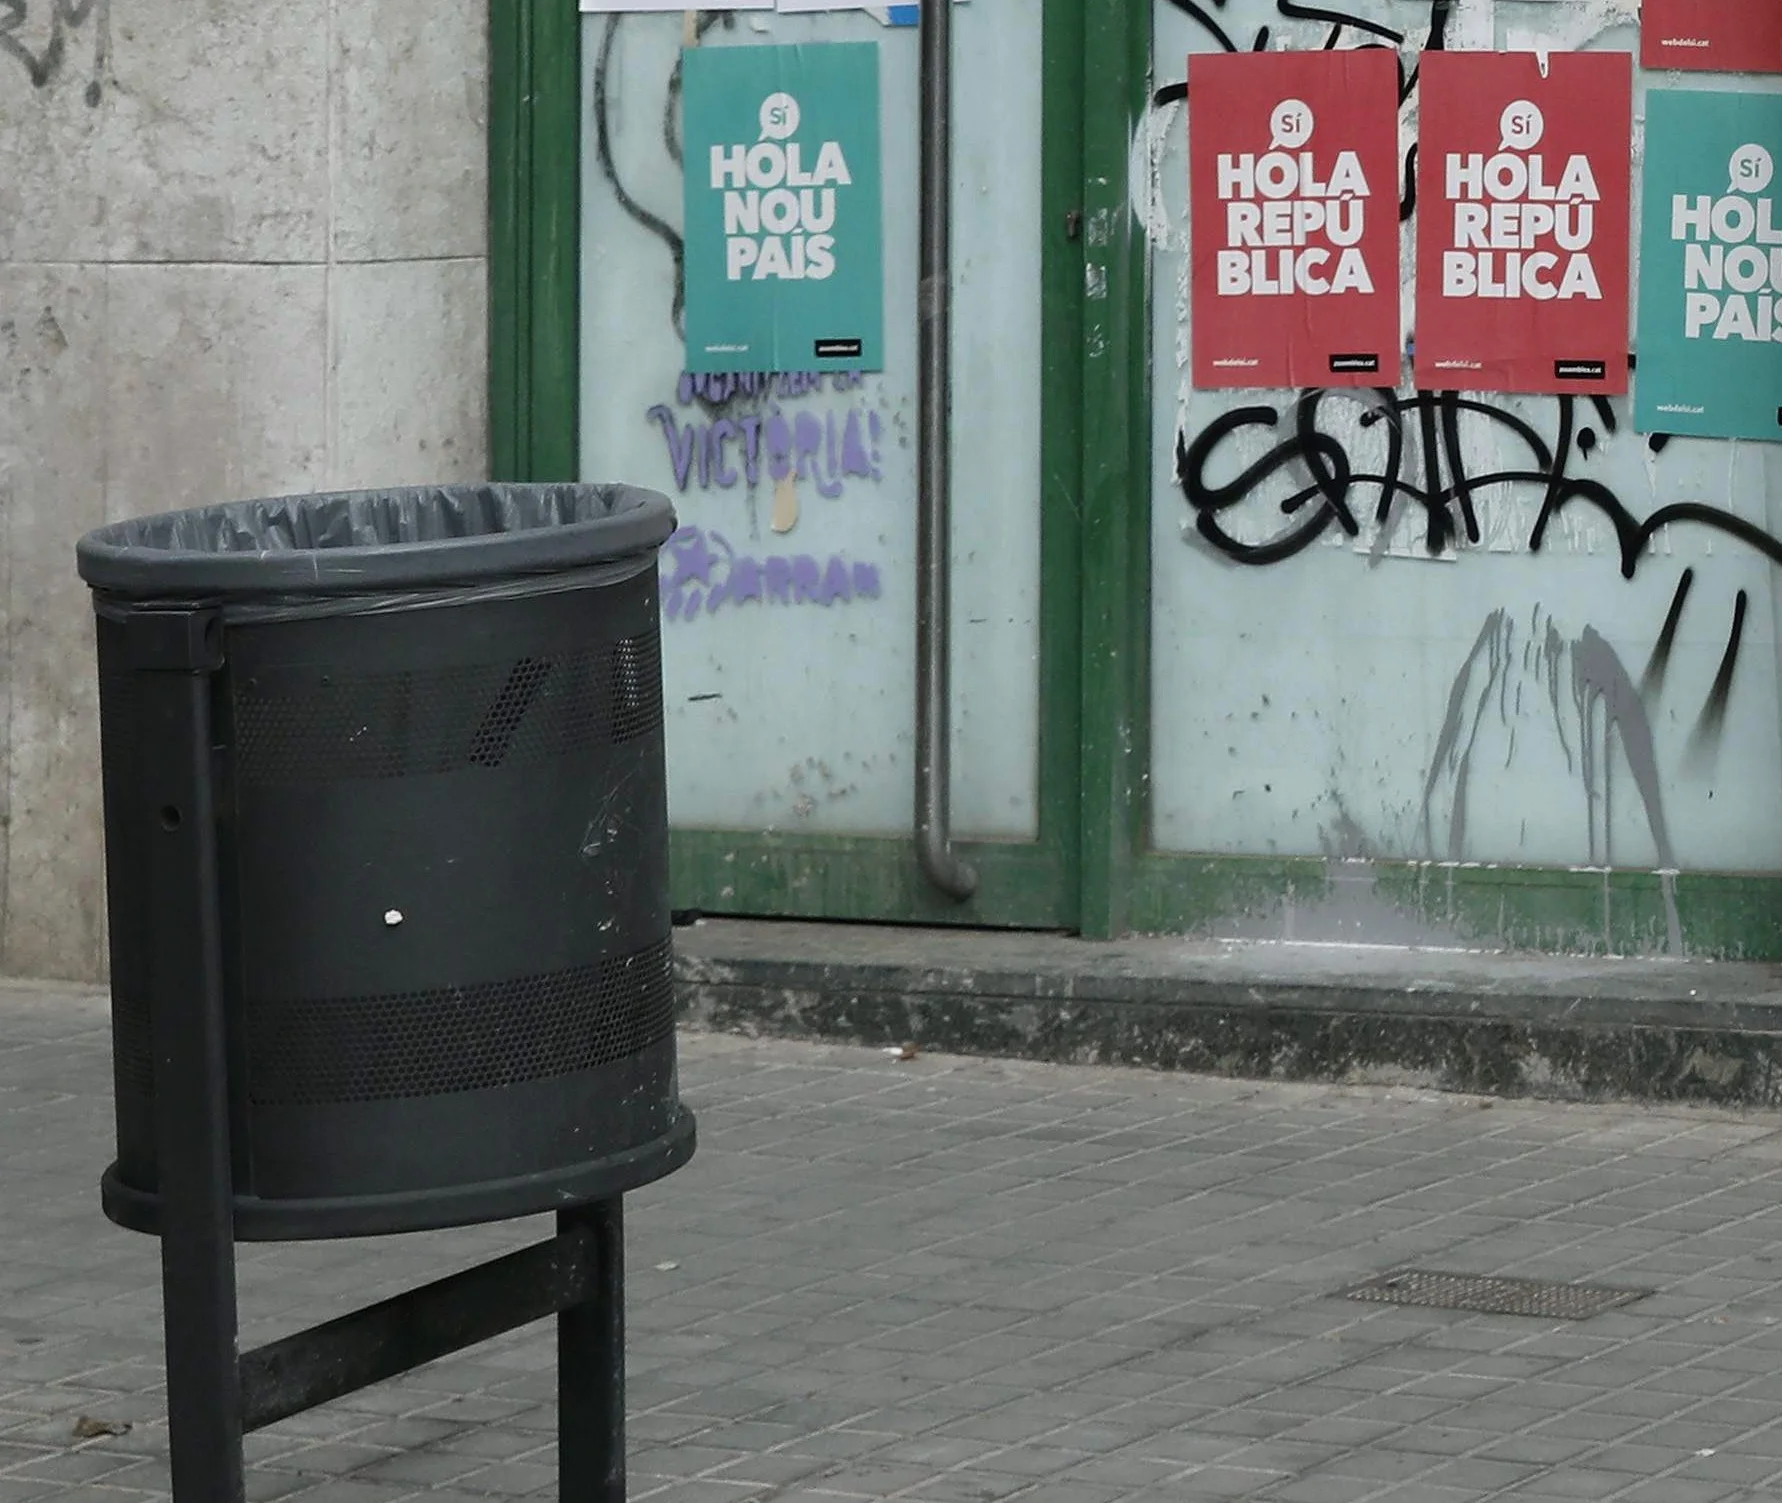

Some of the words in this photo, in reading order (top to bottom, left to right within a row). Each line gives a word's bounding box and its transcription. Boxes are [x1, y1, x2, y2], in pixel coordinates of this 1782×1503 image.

[710, 141, 851, 188] HOLA
[1217, 150, 1371, 200] HOLA
[1446, 153, 1601, 201] HOLA
[724, 189, 835, 233] NOU
[1227, 194, 1365, 247] REPÚ
[1454, 195, 1594, 251] REPÚ
[727, 227, 835, 281] PAÍS
[1217, 248, 1375, 295] BLICA
[1442, 251, 1603, 300] BLICA
